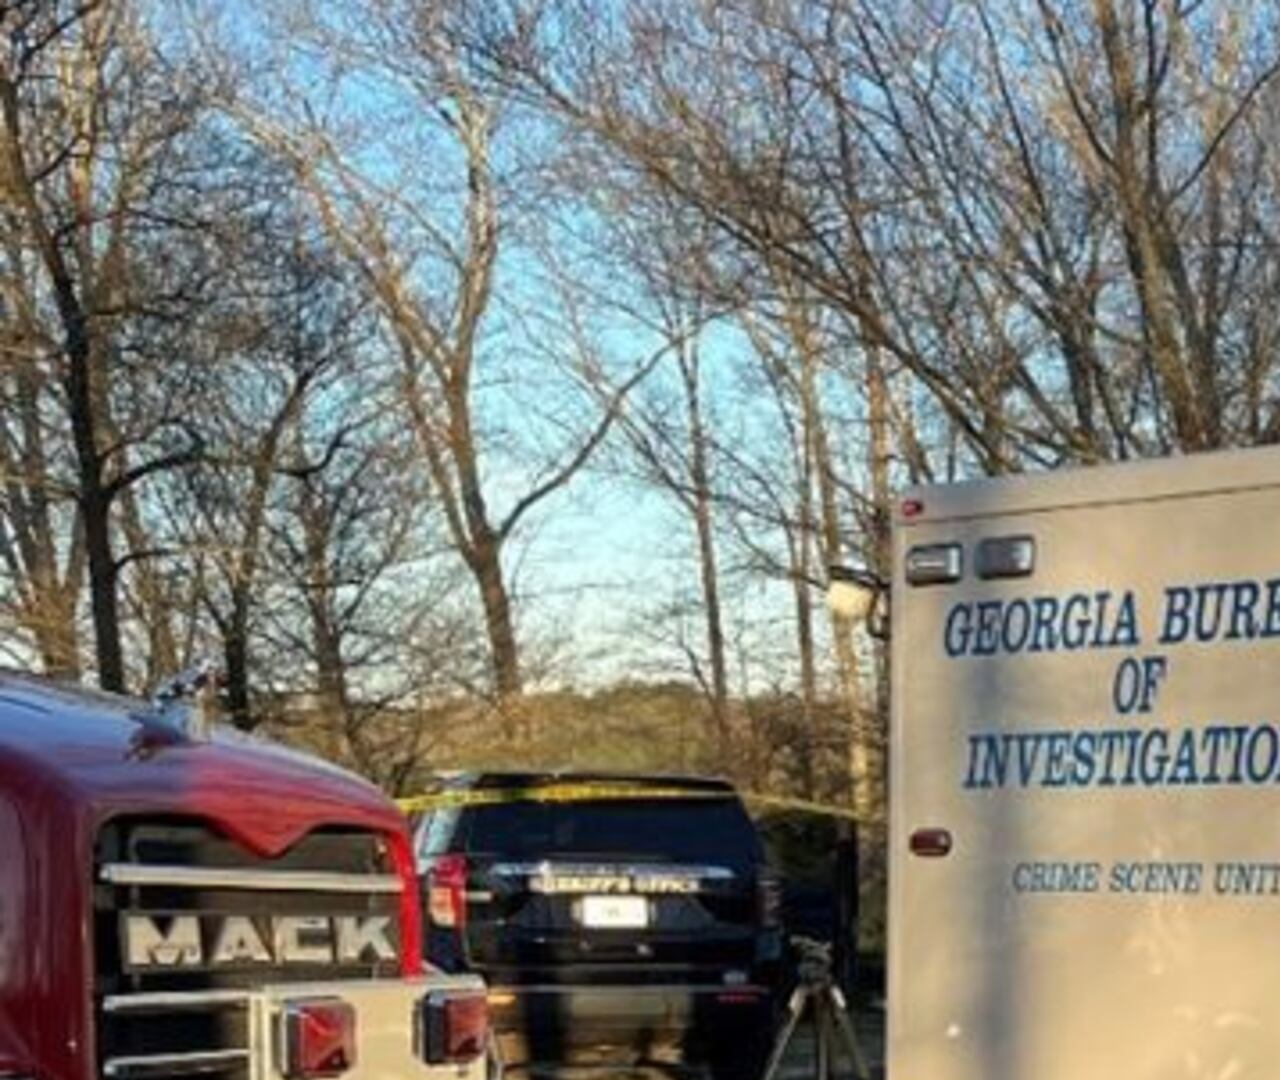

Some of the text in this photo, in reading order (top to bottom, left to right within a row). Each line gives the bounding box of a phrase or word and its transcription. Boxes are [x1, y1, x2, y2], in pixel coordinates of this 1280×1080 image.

[944, 590, 1140, 657] GEORGIA
[1113, 655, 1168, 714] OF
[1012, 862, 1100, 893] CRIME
[1109, 862, 1203, 894] SCENE
[126, 914, 398, 966] MACK
